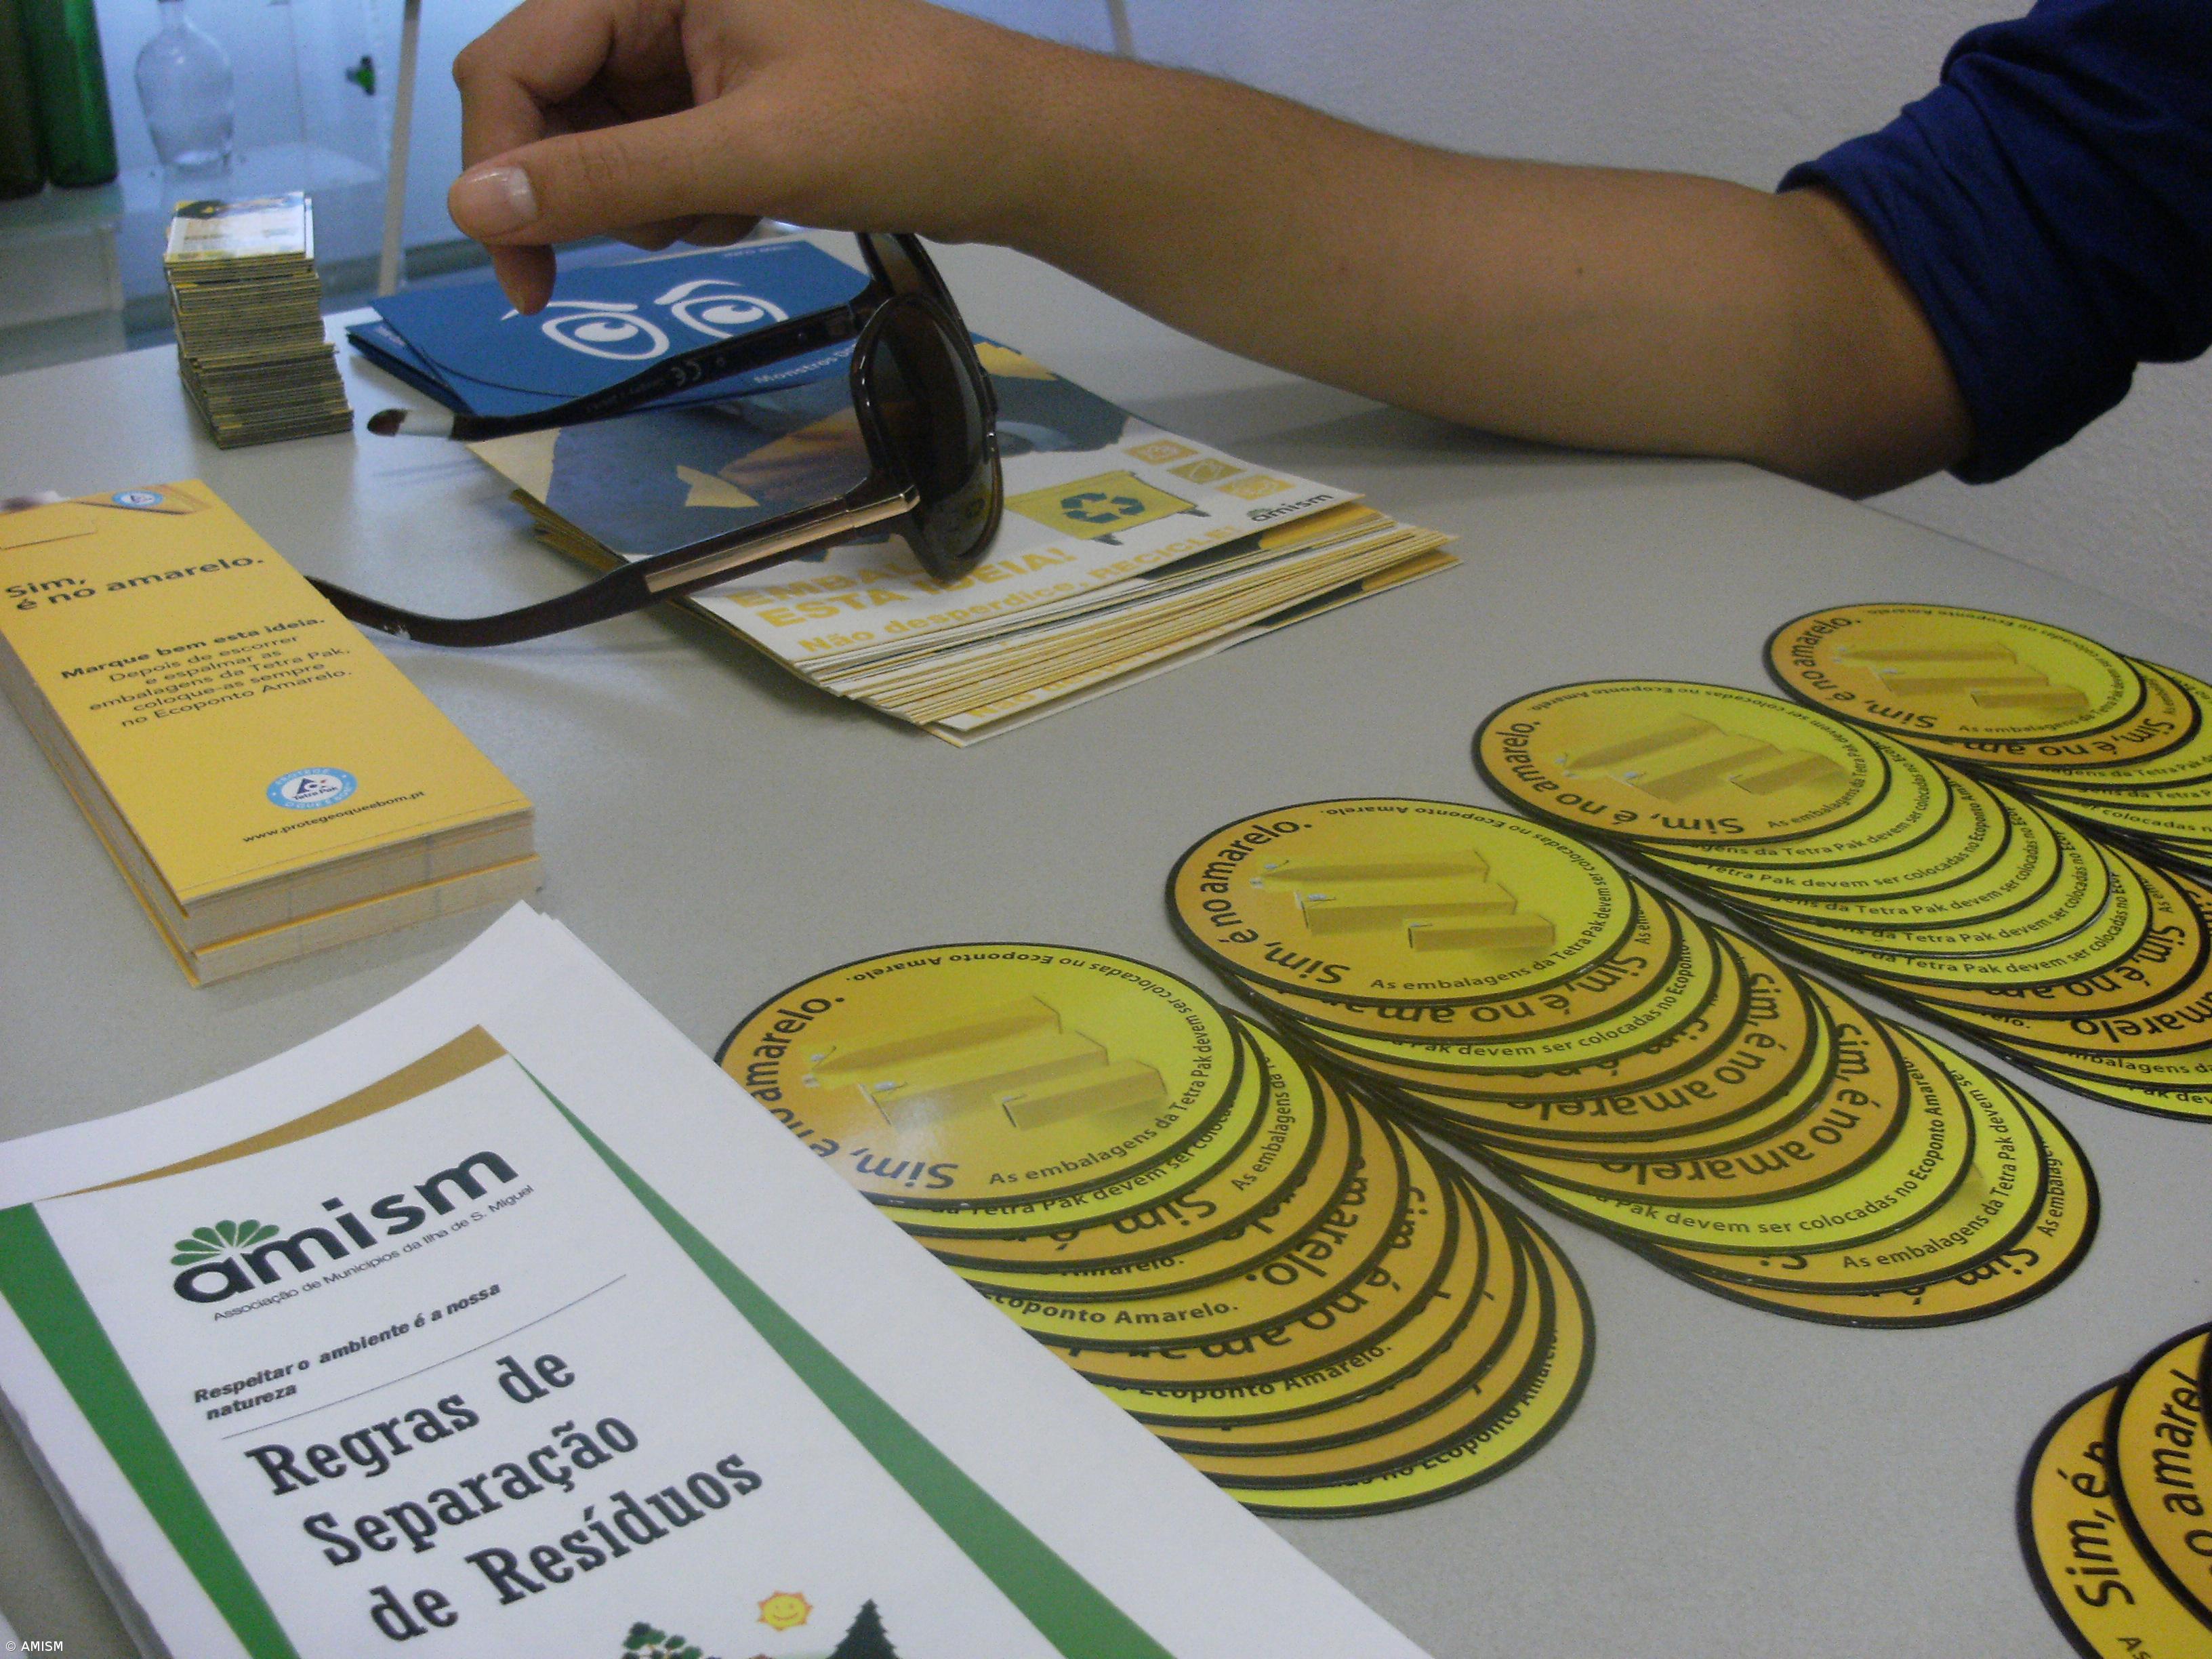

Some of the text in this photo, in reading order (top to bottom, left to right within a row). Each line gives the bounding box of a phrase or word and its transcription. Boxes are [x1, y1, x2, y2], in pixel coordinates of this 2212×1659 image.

[1247, 493, 1335, 523] amism
[5, 575, 87, 598] Sim,
[16, 557, 264, 611] é no amarelo.
[754, 583, 912, 628] ESTA
[60, 617, 325, 680] Marque bem esta ideia.
[108, 635, 298, 682] Depois de escorrer
[144, 649, 282, 685] e espalmar as
[797, 629, 876, 653] Não
[89, 675, 214, 710] embalagens
[219, 667, 245, 679] da
[248, 656, 304, 671] Tetra
[121, 669, 352, 727] no Ecoponto Amarelo.
[133, 661, 325, 712] coloque-as sempre
[1790, 617, 1938, 729] Sim, no amarelo.
[2037, 744, 2091, 756] no
[2111, 718, 2176, 743] Sim,
[1495, 720, 1745, 835] Sim, é no amarelo.
[1767, 819, 1789, 829] As
[1790, 787, 1859, 824] embalagens
[1760, 840, 1980, 888] Pak devem ser colocadas no
[1781, 820, 1911, 857] Tetra Pak devem
[1200, 821, 1351, 984] Sim, é no amarelo.
[1319, 805, 1612, 991] As embalagens da Tetra Pak devem ser colocadas no Ecoponto Amarelo.
[1856, 879, 2020, 916] Tetra Pak devem ser
[1959, 907, 2070, 943] Pak devem ser
[1963, 909, 2129, 974] Pak devem ser colocadas
[2113, 965, 2151, 987] é
[1458, 1044, 1536, 1057] devem
[1542, 1040, 1573, 1054] ser
[1578, 1009, 1662, 1047] colocadas
[1656, 995, 1677, 1011] no
[1469, 1001, 1537, 1023] no
[1538, 993, 1572, 1015] é
[846, 951, 1212, 1185] As embalagens da Tetra Pak devem ser colocadas no Ecoponto Amarelo.
[1713, 1032, 1788, 1084] é no
[745, 997, 959, 1189] Sim, amarelo.
[1809, 1088, 1882, 1145] é no
[1230, 1174, 1258, 1191] As
[1252, 1088, 1296, 1173] embalagens
[1092, 1166, 1168, 1202] devem
[1665, 1119, 1945, 1233] devem ser colocadas no Ecoponto
[1843, 1089, 2017, 1269] As embalagens da Tetra Pak devem
[172, 1150, 518, 1304] amism
[213, 1184, 535, 1322] Associação de Municípios da Ilha de S. Miguel
[2036, 1219, 2060, 1237] As
[1114, 1300, 1239, 1325] Amarelo.
[194, 1283, 501, 1403] Respeitar o ambiente é a nossa
[206, 1384, 298, 1420] natureza
[244, 1352, 576, 1496] Regras de
[302, 1416, 639, 1567] Separação
[369, 1454, 763, 1642] de Resíduos
[2056, 1467, 2135, 1608] Sim, é
